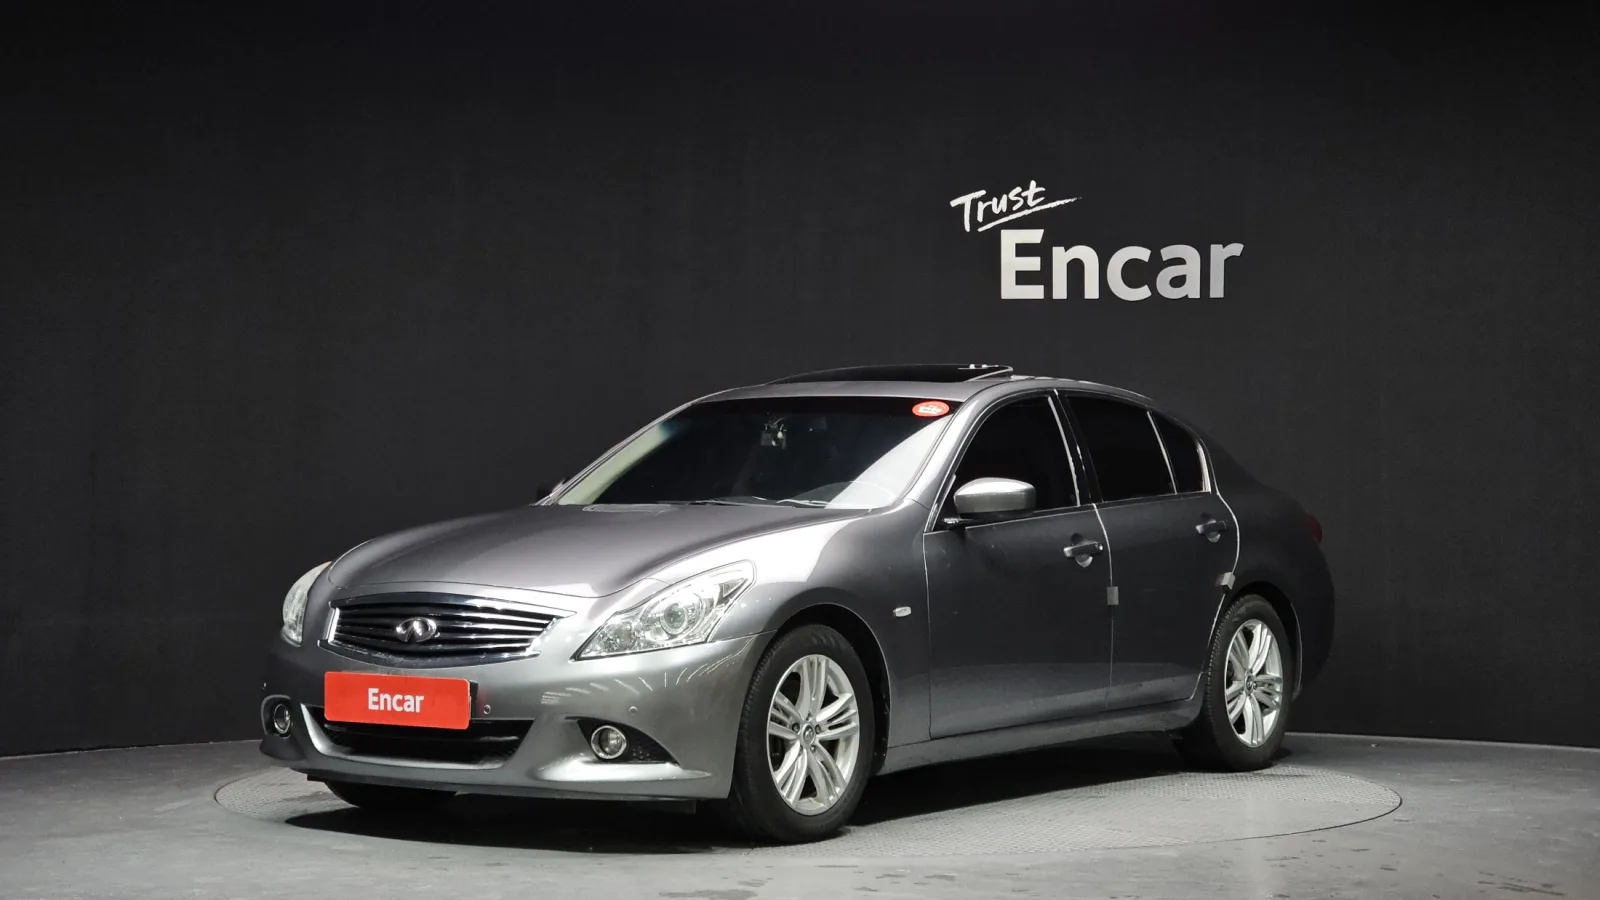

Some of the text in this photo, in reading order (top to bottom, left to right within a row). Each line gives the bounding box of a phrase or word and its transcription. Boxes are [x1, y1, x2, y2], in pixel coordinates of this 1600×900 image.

[950, 180, 1046, 233] Trust
[1000, 228, 1244, 302] Encar
[367, 688, 424, 713] Encar
